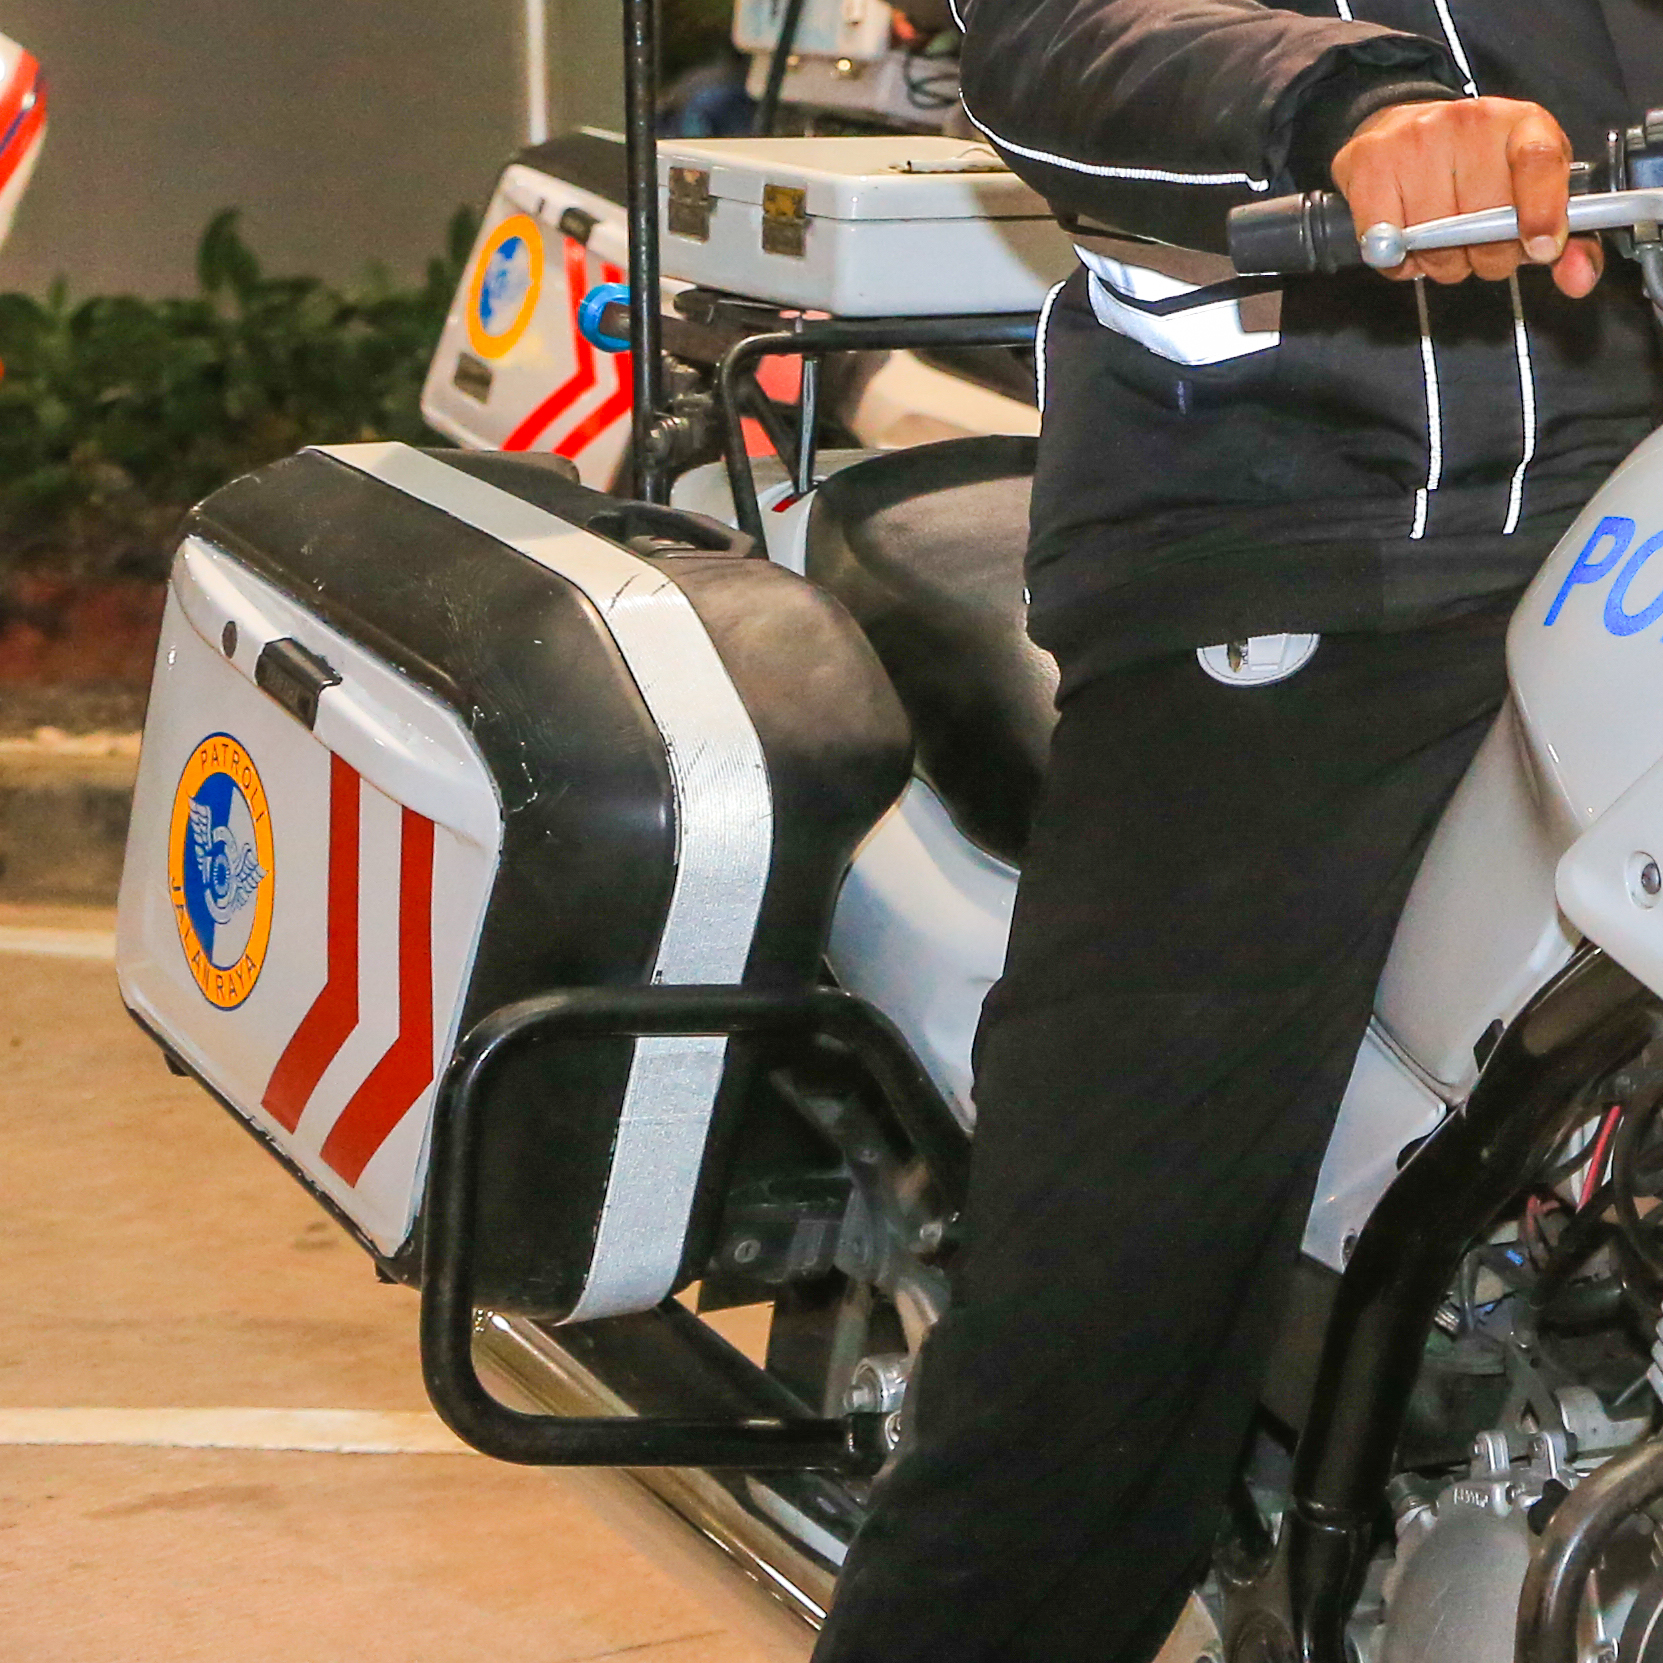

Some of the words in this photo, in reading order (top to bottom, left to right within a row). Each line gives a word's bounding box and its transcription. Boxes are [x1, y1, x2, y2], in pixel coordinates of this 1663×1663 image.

[200, 743, 265, 823] PATROLI
[171, 876, 210, 993] JALAN
[215, 953, 256, 1002] RAYA
